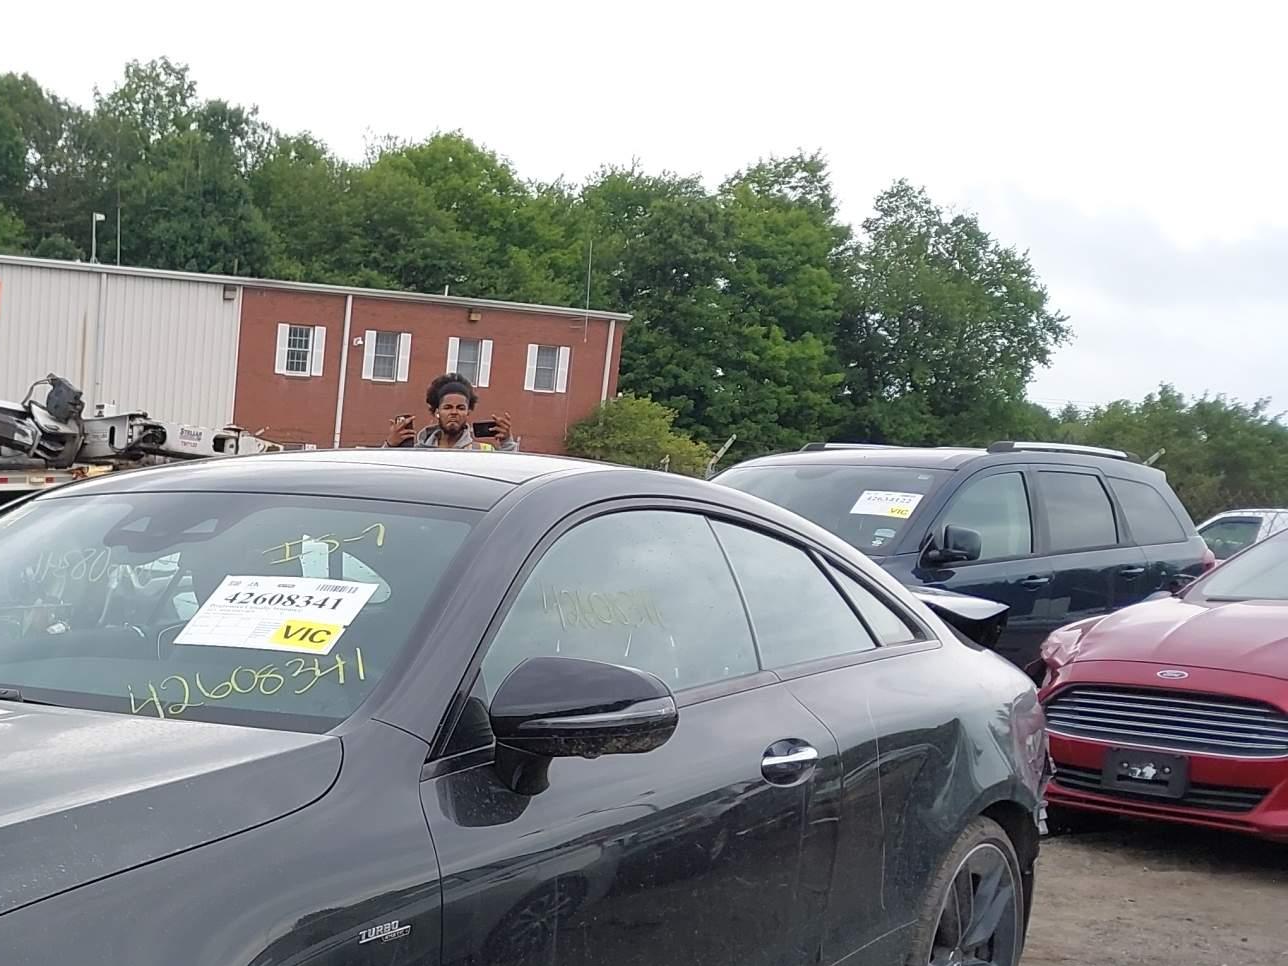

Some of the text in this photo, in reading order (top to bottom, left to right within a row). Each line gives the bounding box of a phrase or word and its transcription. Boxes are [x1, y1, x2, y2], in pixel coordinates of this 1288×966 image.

[224, 592, 344, 610] 42608341
[283, 624, 332, 644] VIC
[127, 647, 365, 719] 42608341
[359, 920, 399, 940] TURBO
